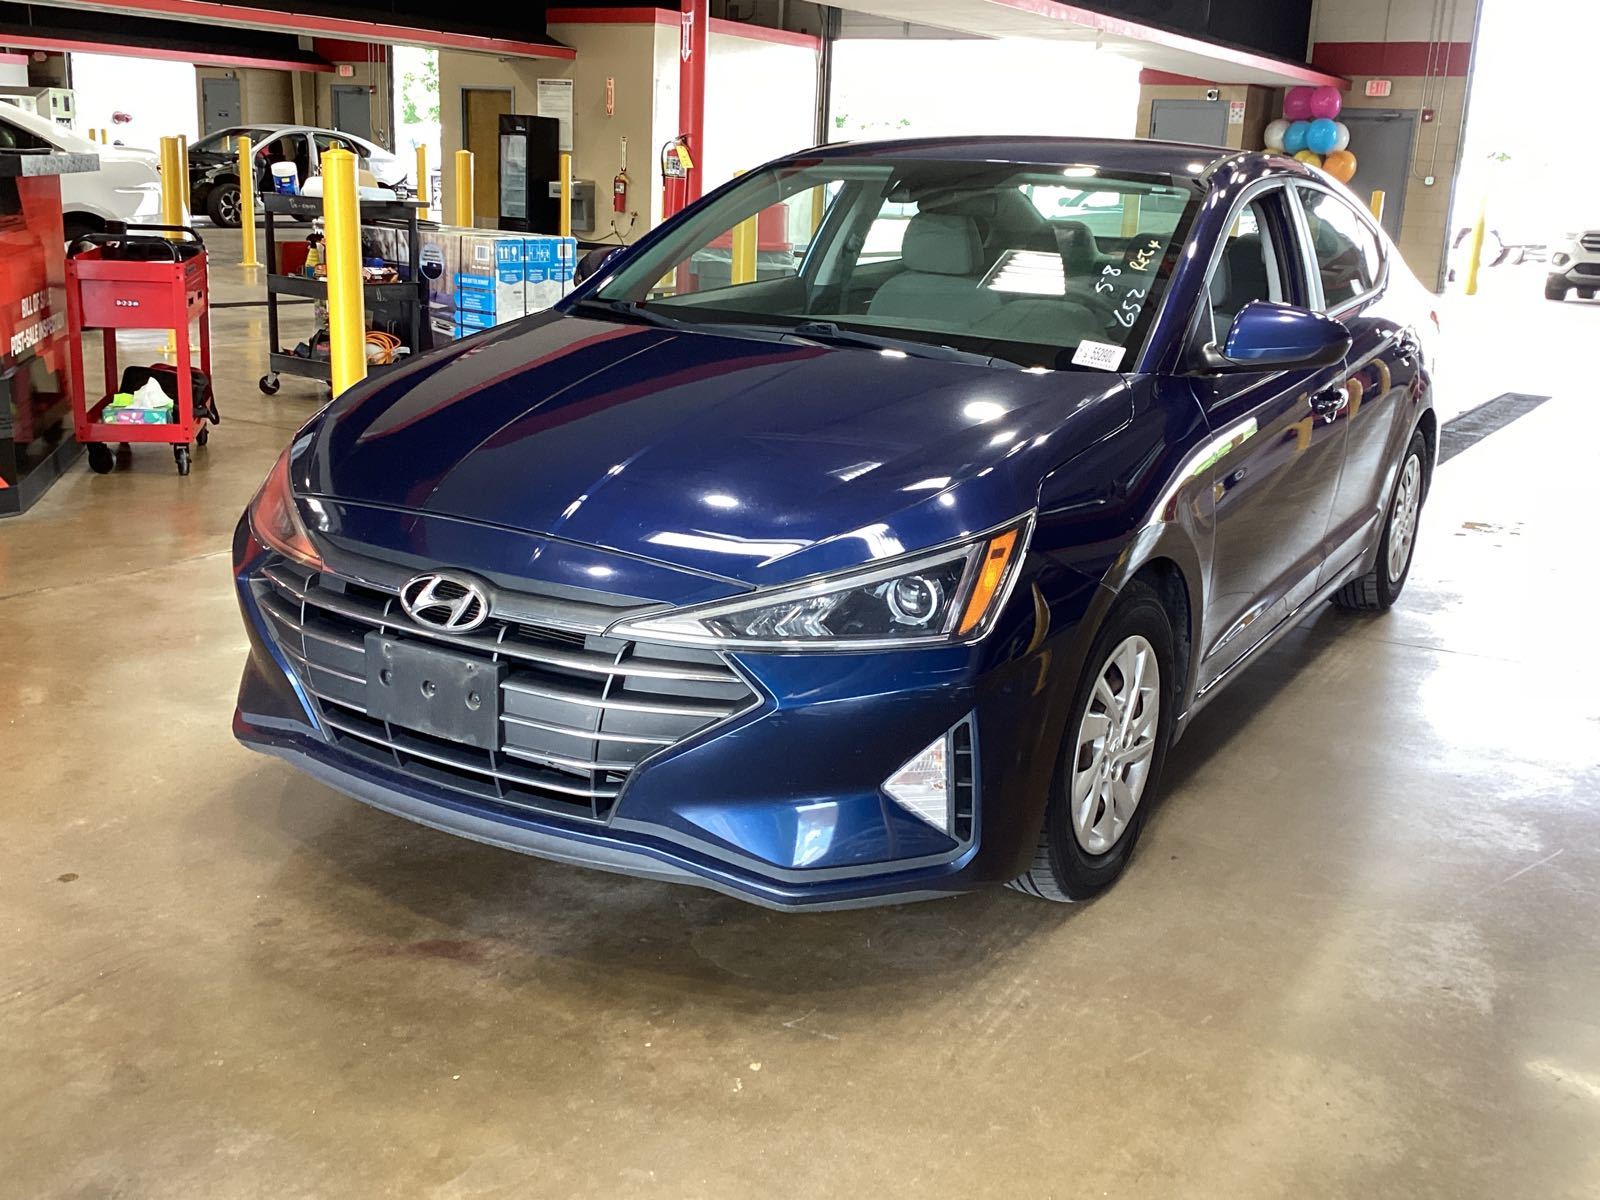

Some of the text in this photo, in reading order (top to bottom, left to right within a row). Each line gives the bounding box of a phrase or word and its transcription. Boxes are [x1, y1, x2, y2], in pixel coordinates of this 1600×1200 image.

[1369, 80, 1388, 95] EXIT
[21, 295, 34, 319] BILL
[1113, 288, 1146, 328] 652
[10, 323, 39, 357] POST-SALE
